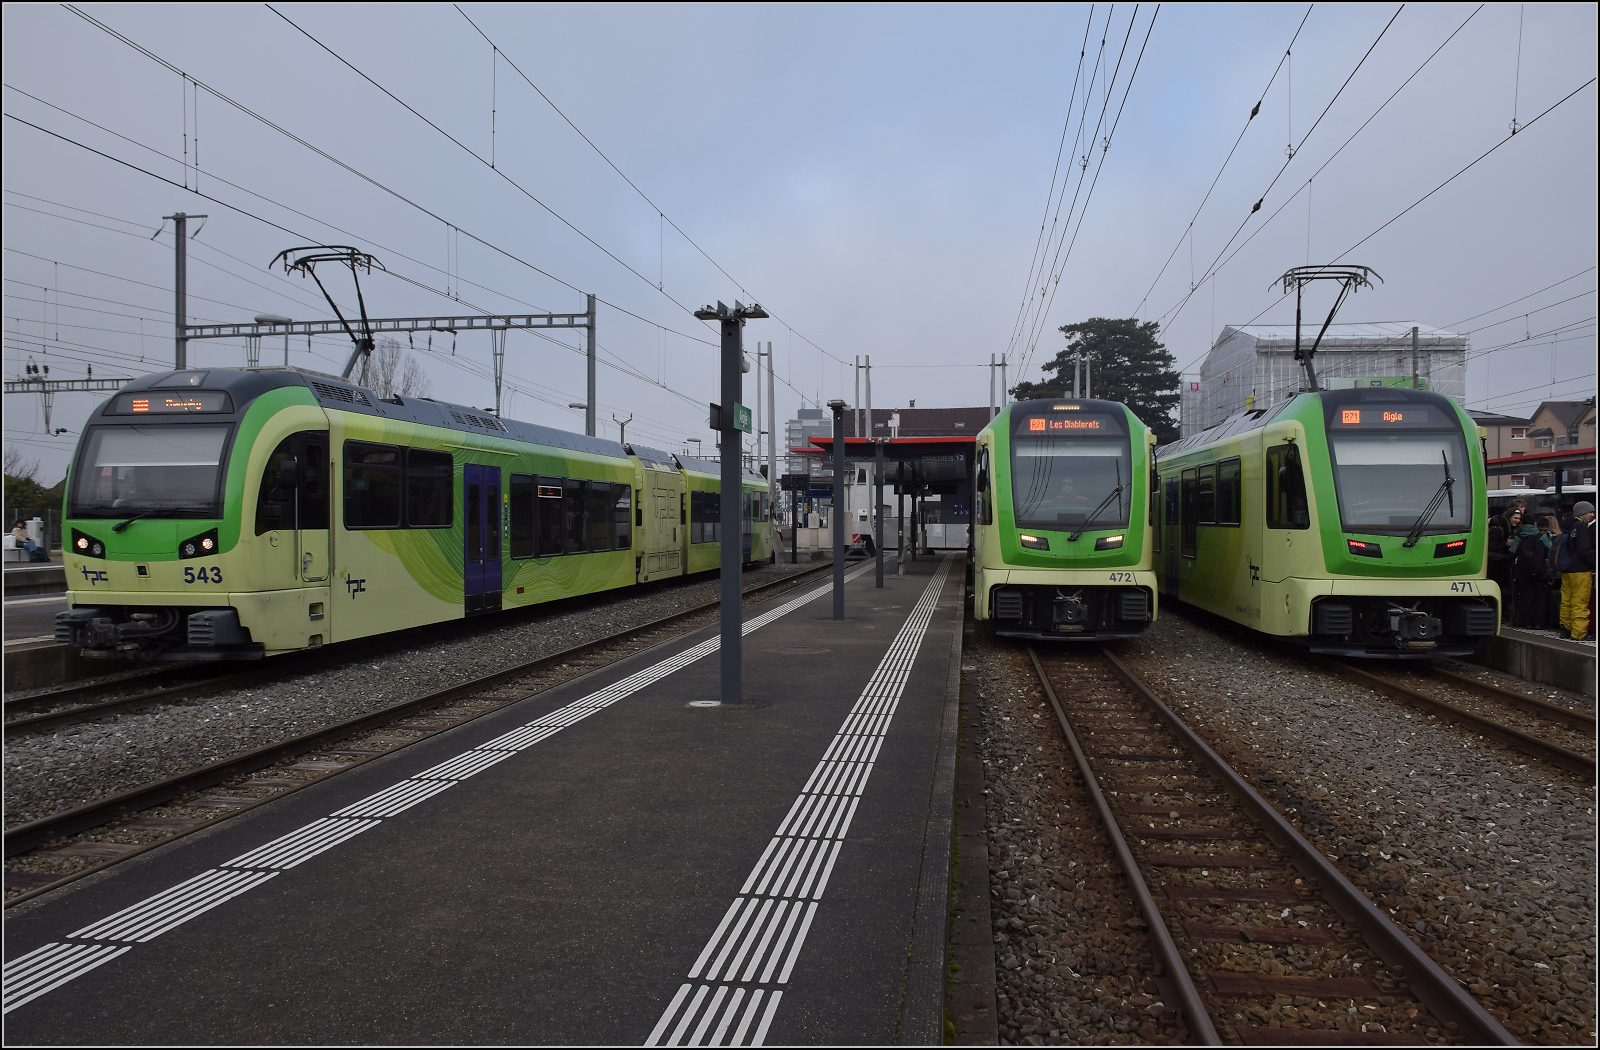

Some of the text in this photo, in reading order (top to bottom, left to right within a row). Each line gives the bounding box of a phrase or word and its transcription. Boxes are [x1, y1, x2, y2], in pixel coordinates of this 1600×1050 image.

[739, 409, 748, 428] Aigle
[1343, 411, 1403, 423] R71 Aigle
[1049, 420, 1063, 429] Les
[1064, 420, 1100, 429] Diablerets
[184, 566, 223, 584] 543
[1109, 572, 1132, 583] 472
[1450, 581, 1473, 593] 471
